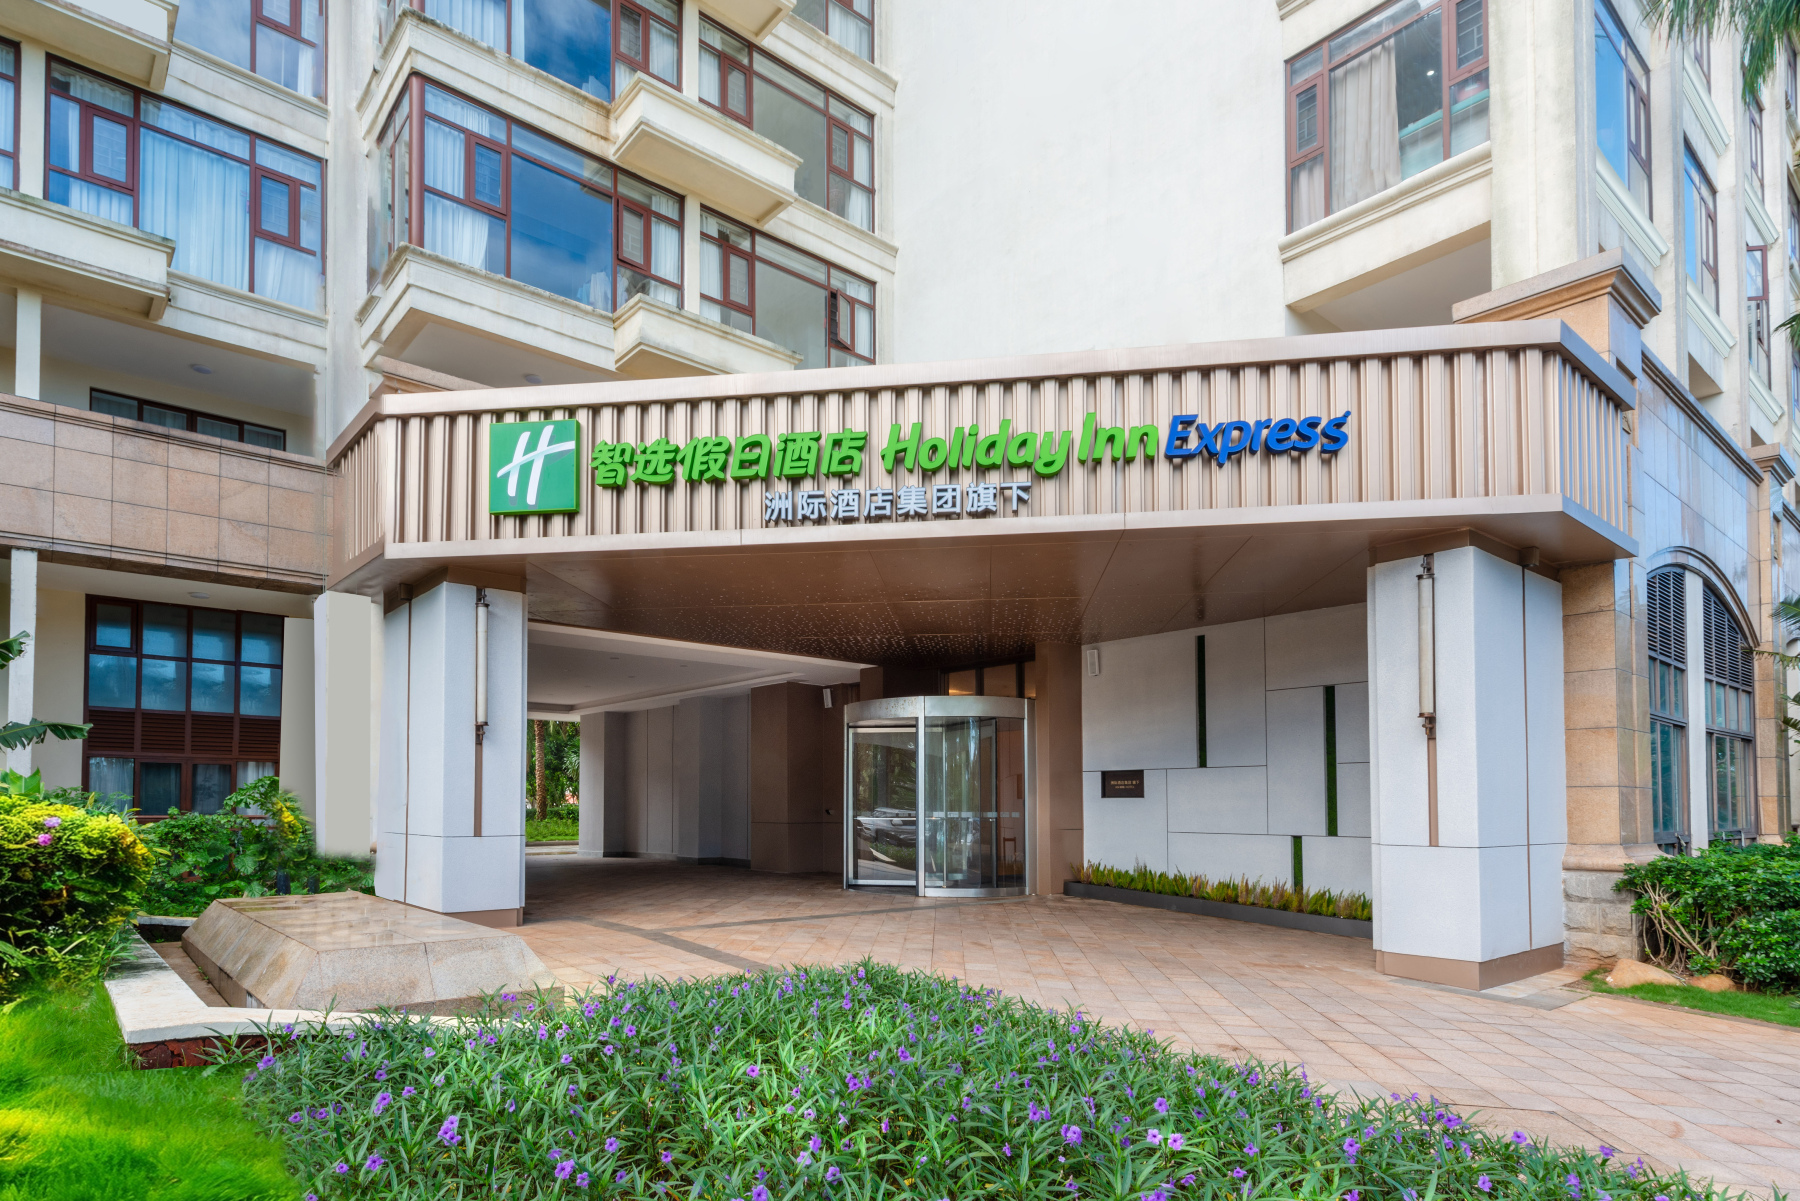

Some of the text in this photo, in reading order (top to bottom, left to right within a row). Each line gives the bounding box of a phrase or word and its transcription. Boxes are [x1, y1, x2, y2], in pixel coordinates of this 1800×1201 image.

[590, 428, 868, 488] 智选假日酒店
[881, 410, 1351, 477] Holiday Inn Express
[764, 482, 1032, 522] 洲际酒店集团旗下
